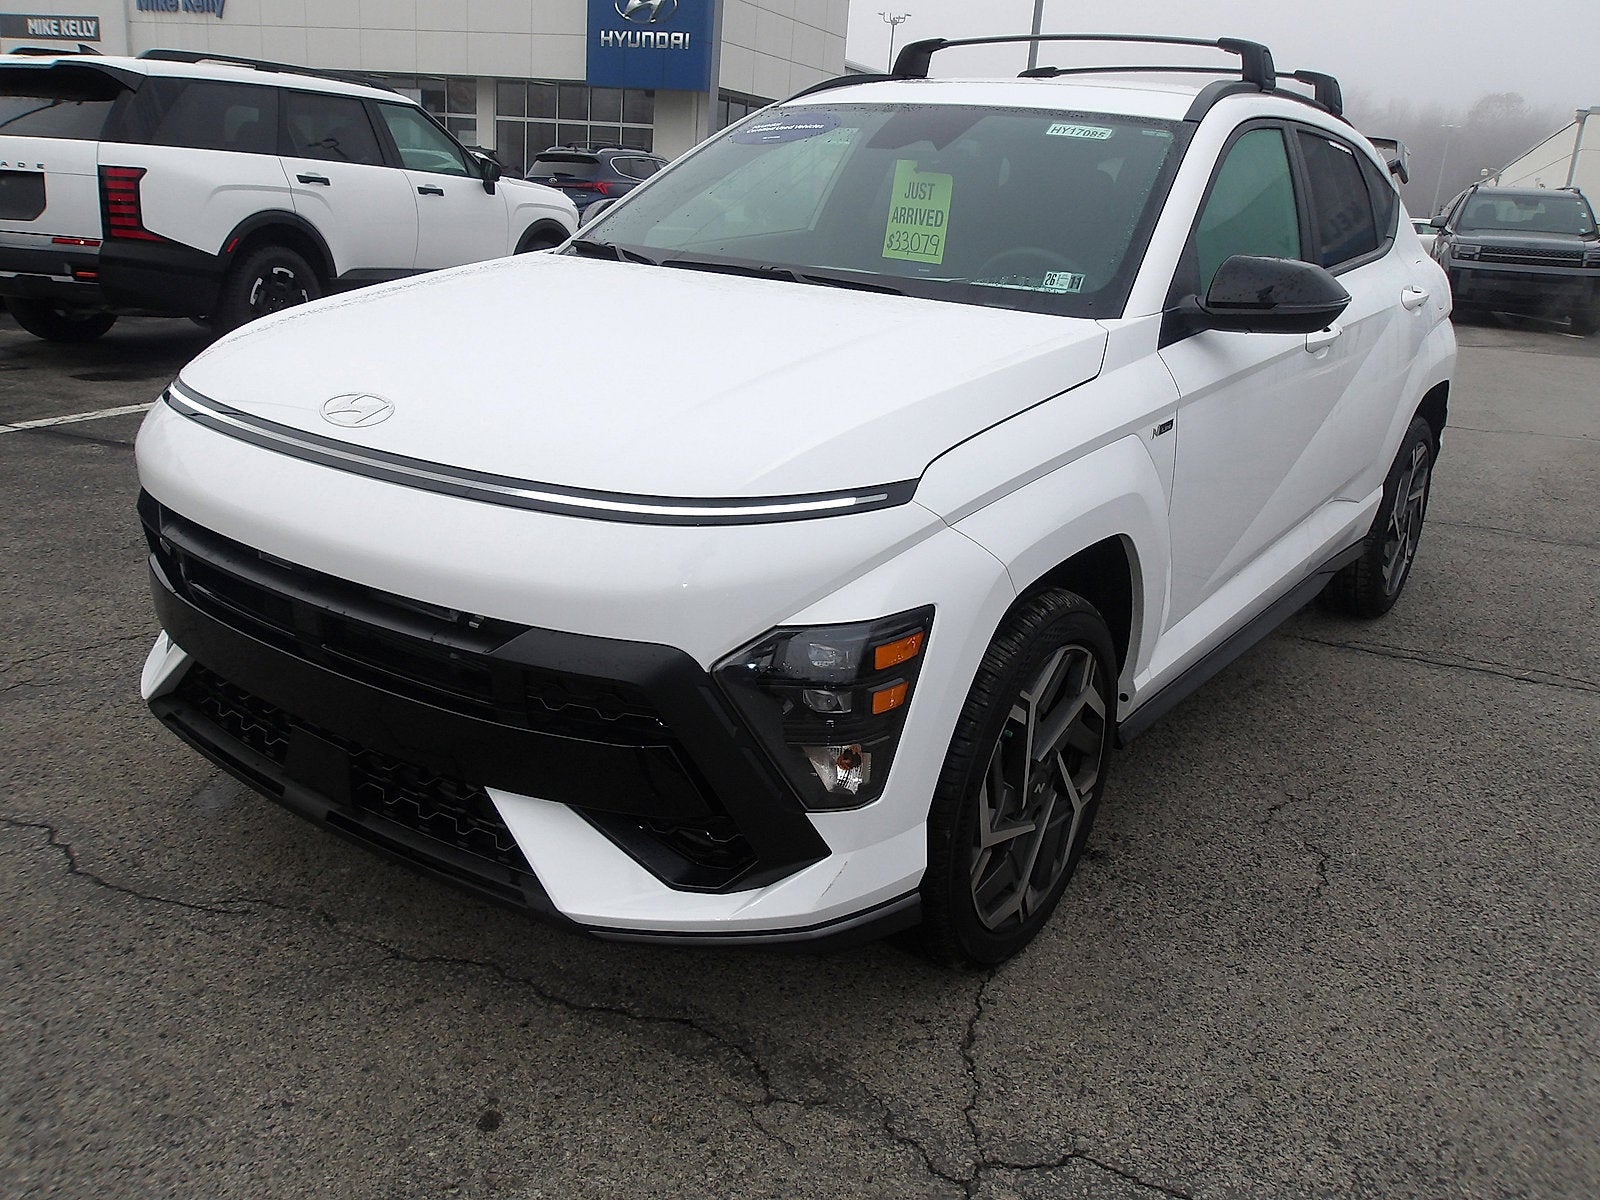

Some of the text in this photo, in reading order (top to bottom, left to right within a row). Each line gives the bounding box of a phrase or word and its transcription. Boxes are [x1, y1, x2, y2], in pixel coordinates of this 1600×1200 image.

[26, 18, 97, 38] MIKE KELLY
[600, 30, 690, 49] HYUNDAI
[1050, 126, 1108, 138] HY17085
[904, 181, 936, 201] JUST
[891, 206, 944, 228] ARRIVED
[886, 230, 941, 255] $33079
[1045, 273, 1058, 286] 26
